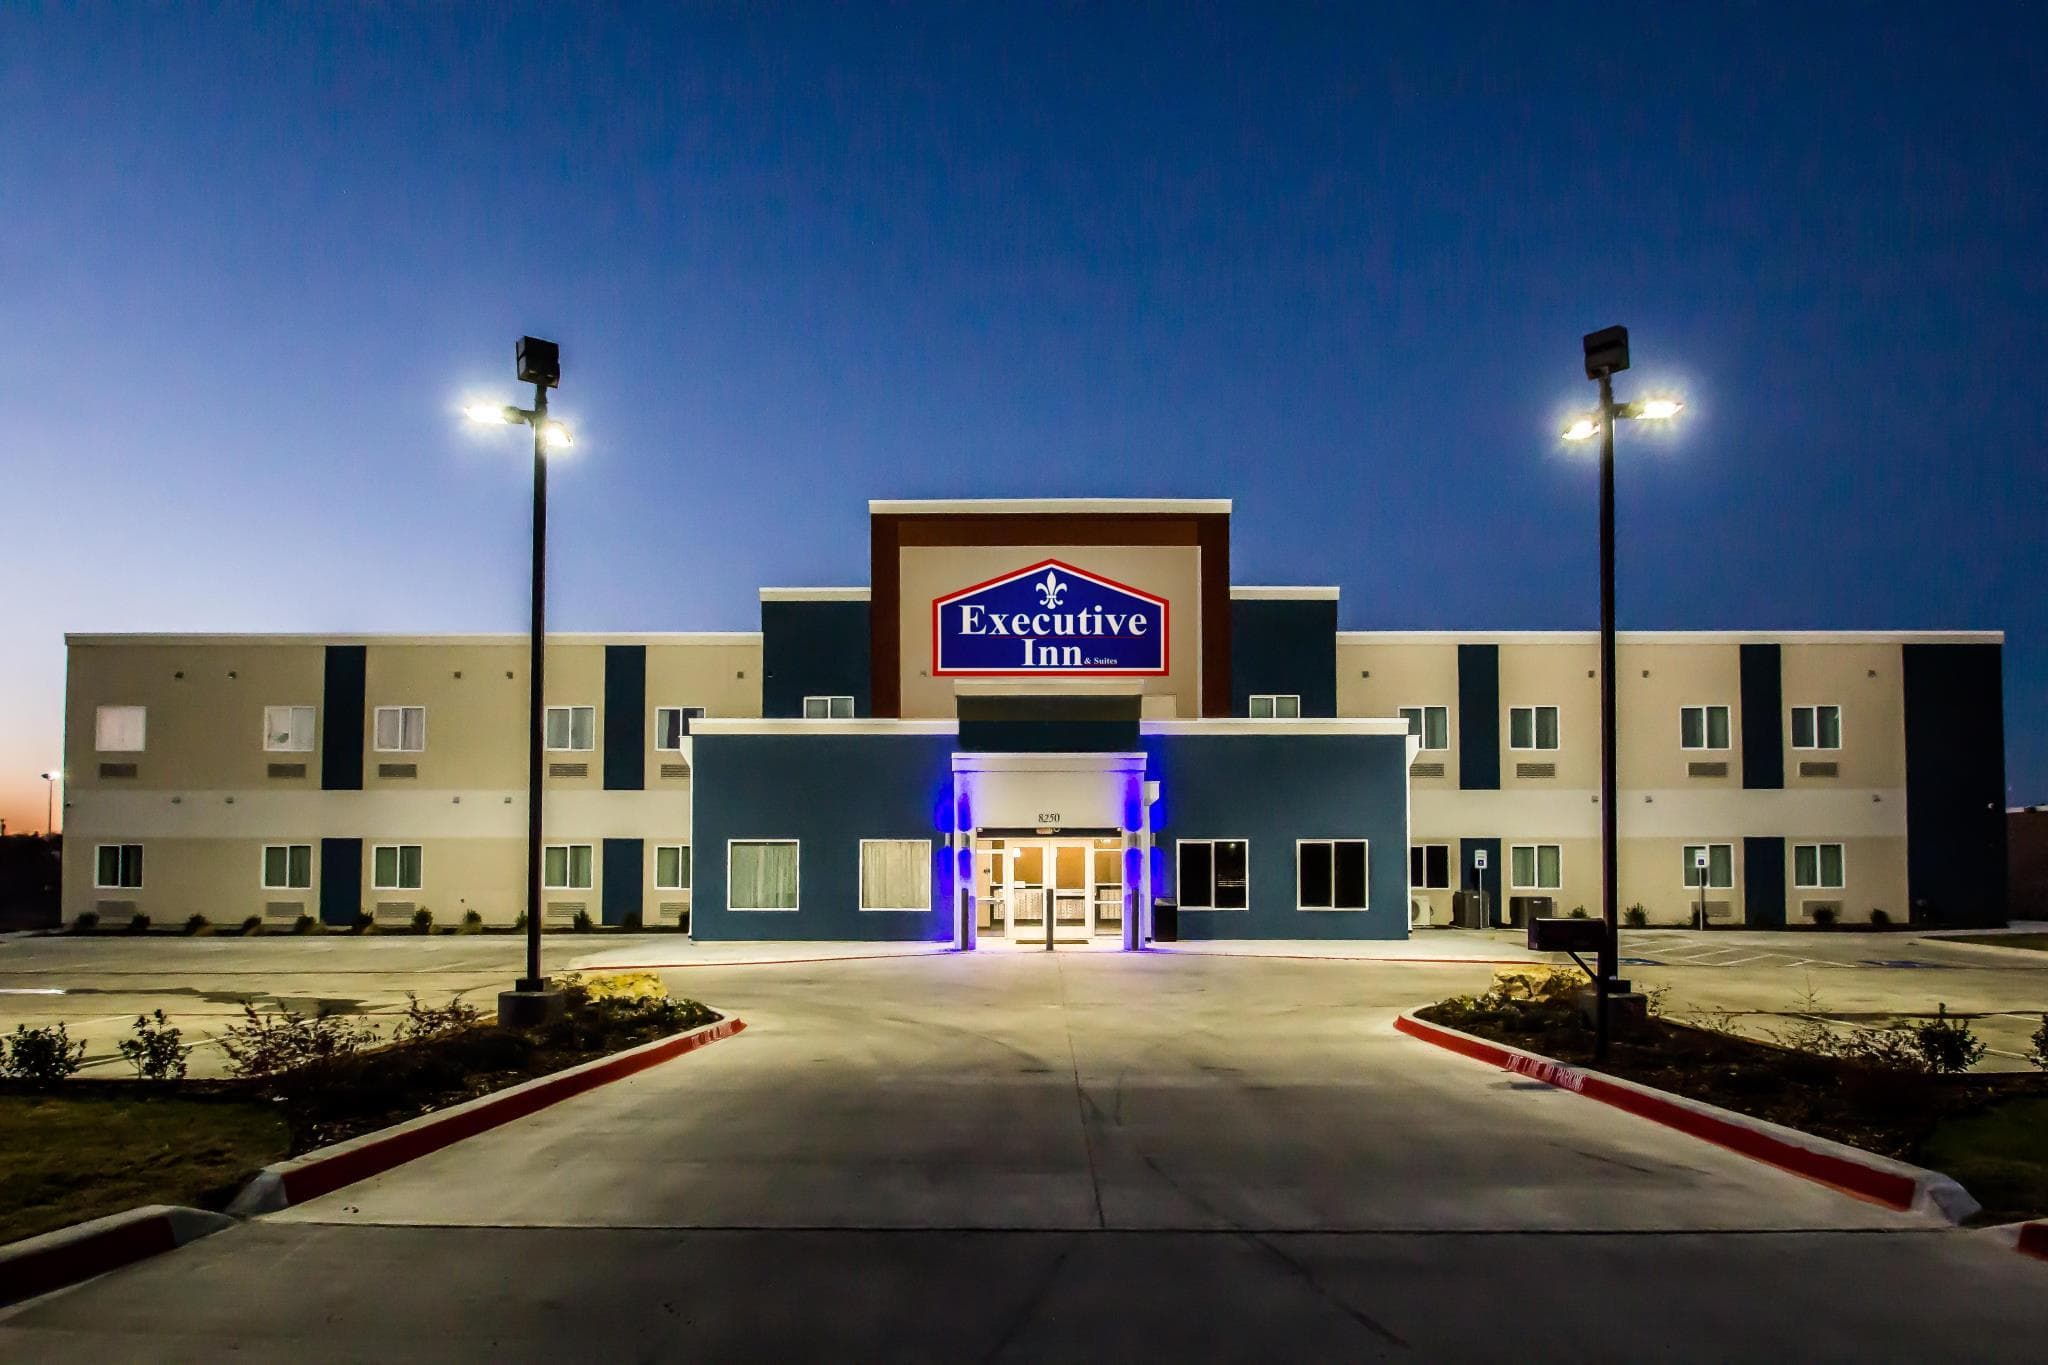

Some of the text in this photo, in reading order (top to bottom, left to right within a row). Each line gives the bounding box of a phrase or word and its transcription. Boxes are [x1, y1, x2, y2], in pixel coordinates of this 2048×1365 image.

[958, 604, 1148, 636] Executive
[1021, 638, 1118, 666] Inn & Suites
[1038, 813, 1060, 823] 8250
